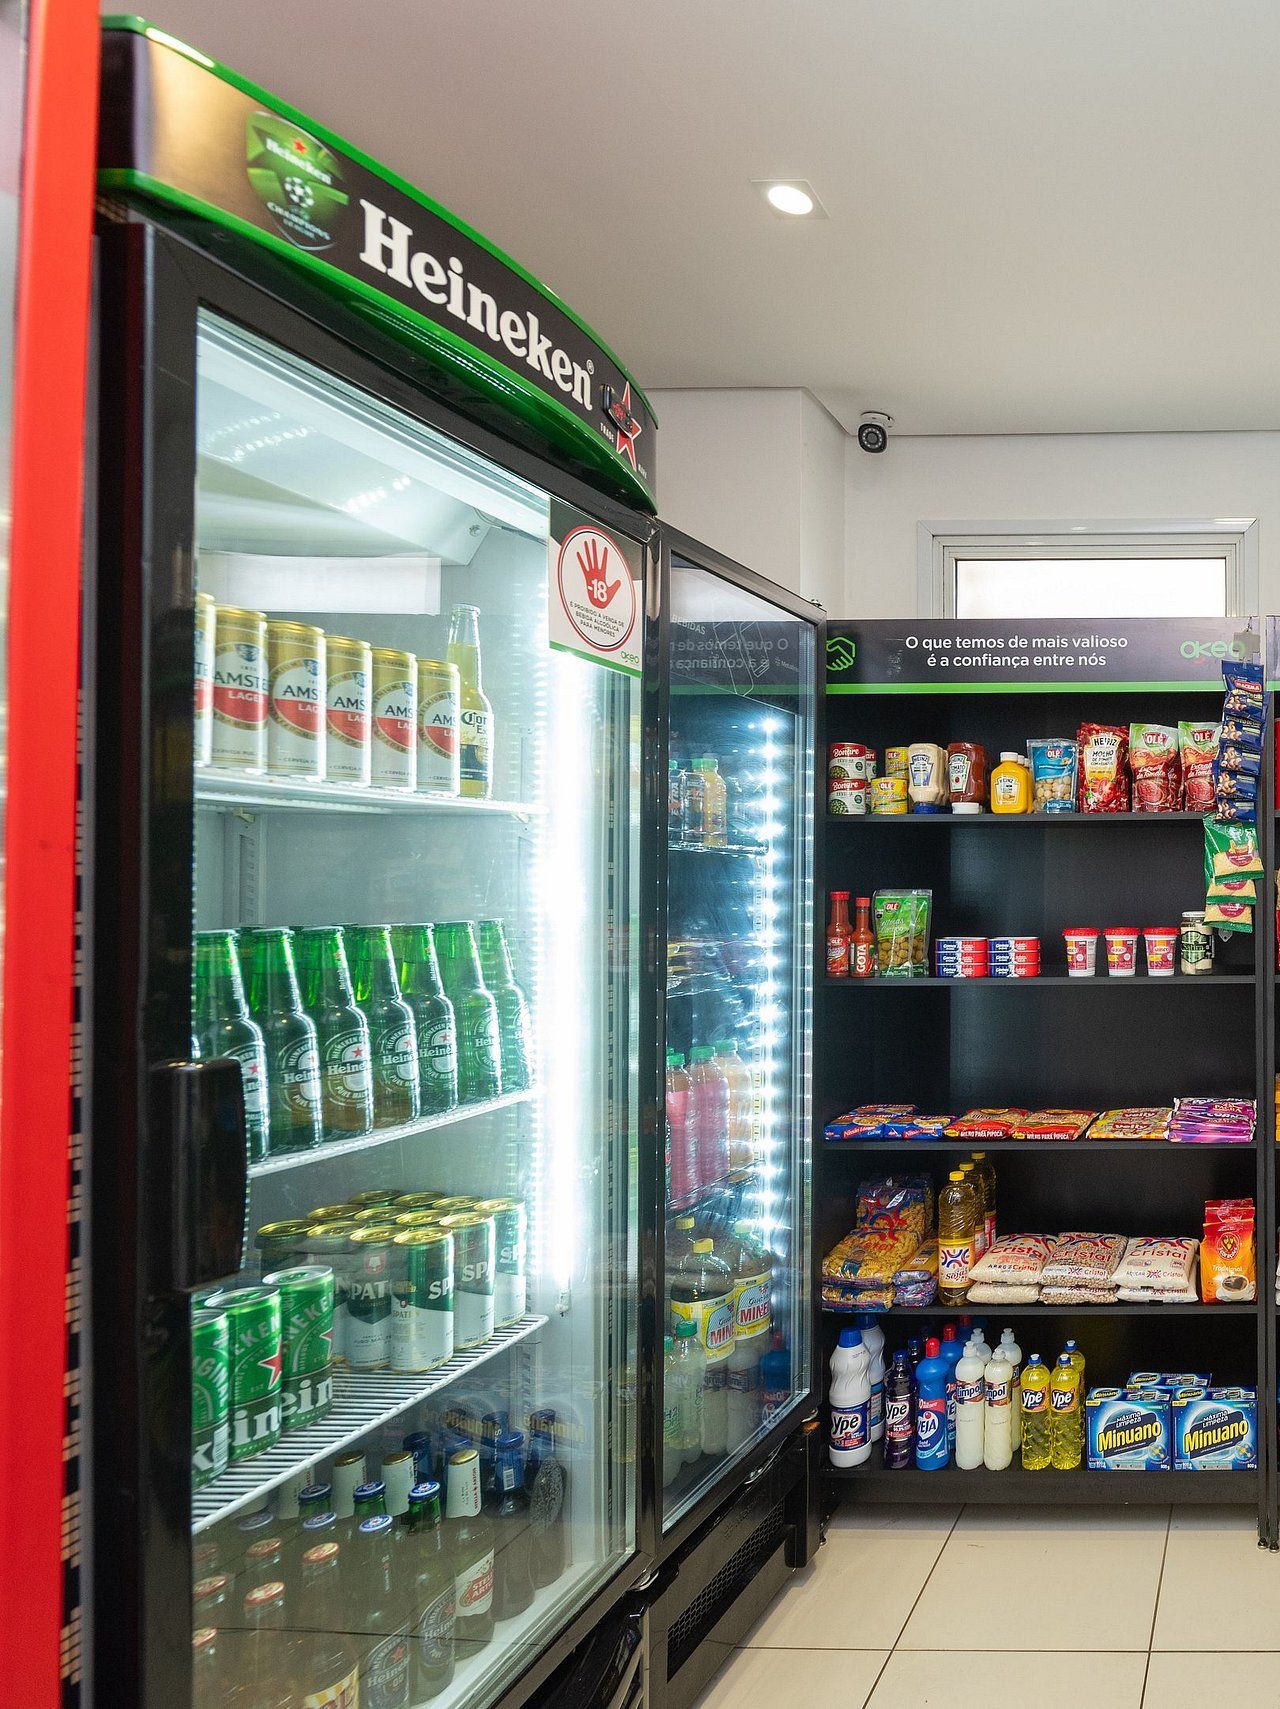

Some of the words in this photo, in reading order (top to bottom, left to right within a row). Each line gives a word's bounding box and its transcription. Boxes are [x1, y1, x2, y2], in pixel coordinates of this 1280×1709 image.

[359, 199, 594, 411] Heineken
[580, 620, 593, 629] PARA
[905, 636, 919, 649] O
[922, 638, 953, 652] que
[955, 637, 1006, 649] temos
[1008, 635, 1028, 648] de
[1031, 635, 1068, 648] mais
[1071, 635, 1128, 648] valioso
[927, 653, 937, 666] é
[940, 656, 949, 666] a
[953, 652, 1030, 668] confiança
[1033, 654, 1075, 666] entre
[1078, 652, 1107, 666] nós
[1098, 1421, 1161, 1453] Minuano
[1184, 1420, 1249, 1453] Minuano
